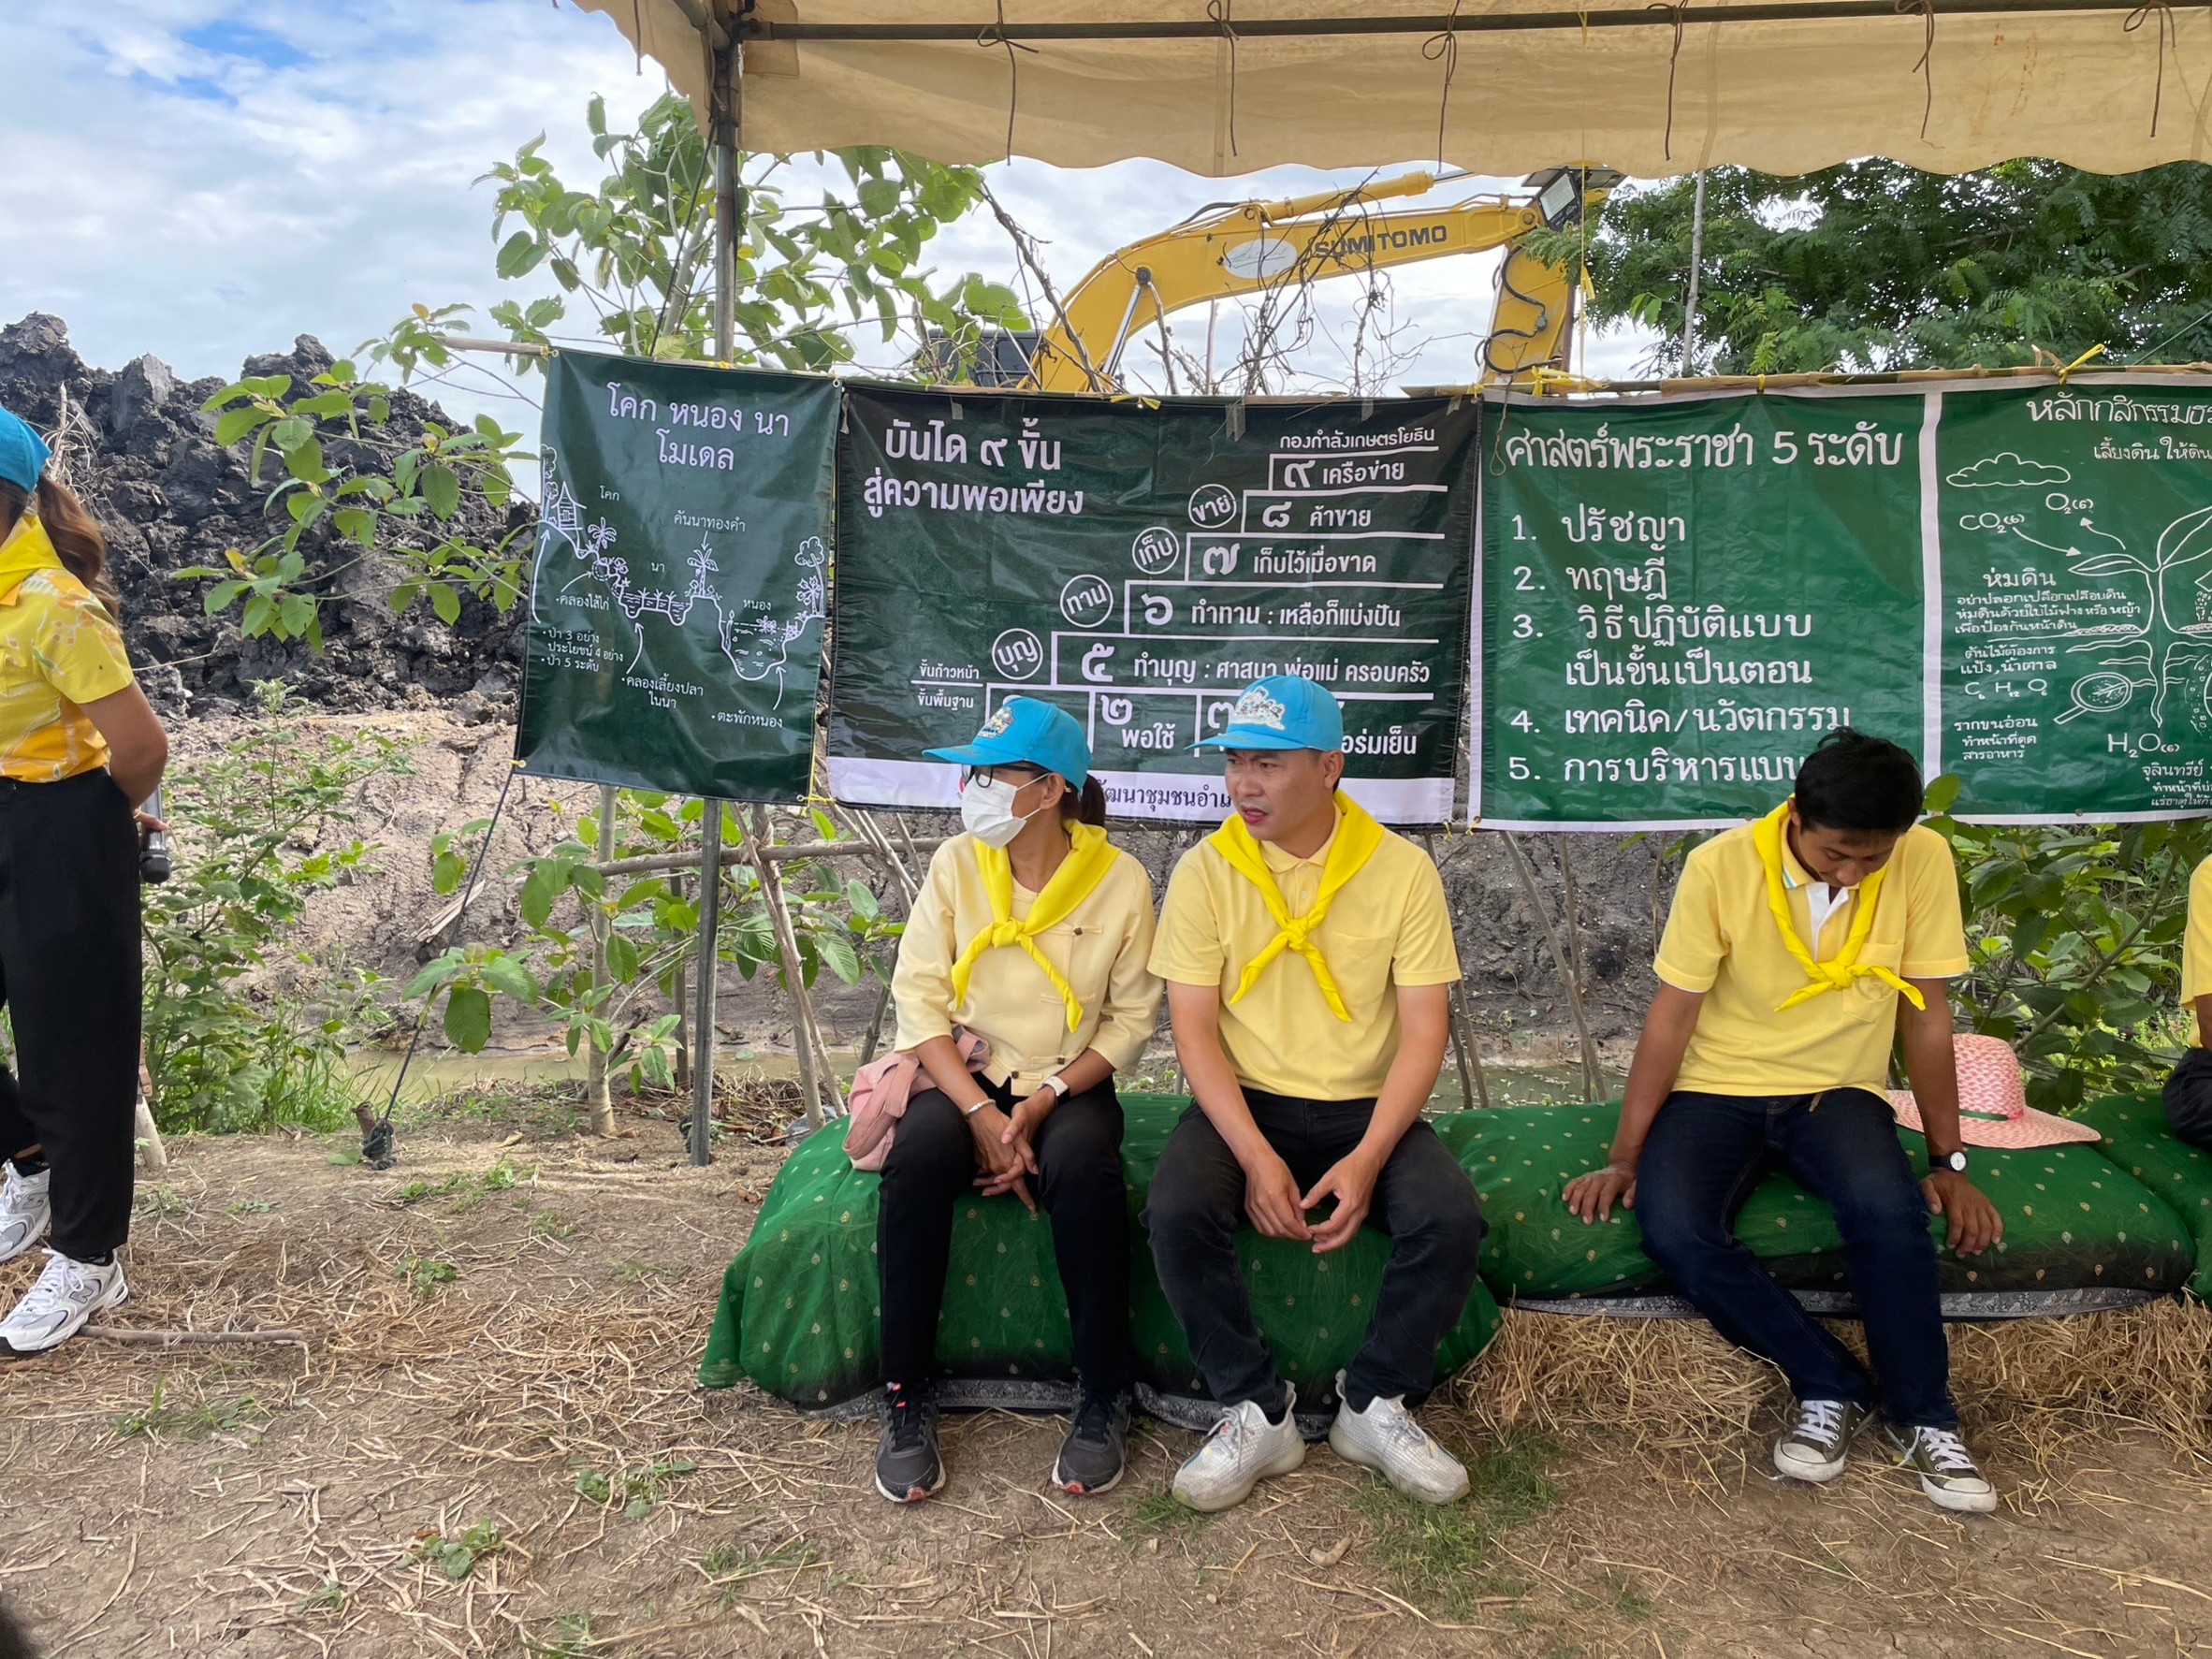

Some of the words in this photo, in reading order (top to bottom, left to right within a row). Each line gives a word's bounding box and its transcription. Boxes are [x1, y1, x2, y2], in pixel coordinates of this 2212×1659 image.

[1315, 226, 1448, 257] SUMITOMO
[606, 382, 657, 421] โคก
[669, 401, 743, 431] หนอง
[754, 411, 790, 437] นา
[655, 428, 735, 470] โมเดล
[885, 418, 968, 464] บันได
[980, 437, 1009, 468] ๙
[1016, 416, 1062, 471] ขั้น
[1279, 426, 1435, 449] กองกำลังเกษตรโยธิน
[1505, 422, 1754, 469] ศาสตร์พระราชา
[1772, 431, 1798, 465] 5
[1808, 421, 1902, 466] ระดับ
[2093, 436, 2160, 460] เลี้ยงดิน
[1283, 459, 1316, 488] ๙
[1322, 459, 1405, 486] เครือข่าย
[599, 485, 620, 502] โคก
[863, 466, 1084, 518] สู่ความพอเพียง
[1192, 494, 1232, 523] ขาย
[1261, 501, 1293, 528] ๘
[1309, 504, 1372, 528] ค้าขาย
[1512, 514, 1537, 541] 1.
[1561, 502, 1685, 551] ปรัชญา
[1138, 534, 1175, 567] เก็บ
[1201, 542, 1241, 576] ๗
[1253, 546, 1376, 575] เก็บไว้เมื่อขาด
[651, 562, 665, 573] นา
[1514, 566, 1546, 590] 2.
[1565, 557, 1667, 601] ทฤษฎี
[1983, 567, 2057, 589] ห่มดิน
[560, 593, 610, 611] คลองไส้ไก่
[743, 599, 772, 611] หนอง
[1065, 584, 1108, 616] ทาน
[1140, 592, 1174, 626] ๖
[1191, 598, 1260, 625] ทำทาน
[1279, 600, 1402, 627] เหลือก็แบ่งปัน
[2109, 601, 2141, 618] หญ้า
[548, 626, 562, 639] ป่า
[566, 631, 573, 640] 3
[575, 631, 600, 644] อย่าง
[1511, 614, 1544, 638] 3.
[1578, 604, 1812, 647] วิธีปฏิบัติแบบ
[546, 654, 561, 666] ป่า
[564, 658, 572, 668] 5
[575, 659, 600, 672] ระดับ
[548, 641, 593, 657] ประโยชน์
[595, 648, 601, 657] 4
[603, 648, 624, 662] อย่าง
[997, 636, 1040, 673] บุญ
[1081, 642, 1115, 682] ๕
[1134, 651, 1197, 686] ทำบุญ
[1216, 660, 1277, 679] ศาสนา
[1285, 657, 1339, 681] พ่อแม่
[1345, 660, 1431, 683] ครอบครัว
[1565, 644, 1812, 686] เป็นขั้นเป็นตอน
[919, 658, 980, 680] ขั้นก้าวหน้า
[626, 673, 704, 697] คลองเลี้ยงปลา
[917, 688, 975, 711] ขั้นพื้นฐาน
[648, 691, 677, 709] ในนา
[1099, 694, 1133, 726] ๒
[717, 709, 783, 729] ตะพักหนอง
[1509, 709, 1541, 734] 4.
[1564, 698, 1850, 734] เทคนิค/นวัตกรรม
[1121, 721, 1176, 749] พอใช้
[1340, 725, 1417, 755] อร่มเย็น
[1508, 756, 1541, 780] 5.
[2142, 758, 2205, 782] จุลินทรีย์
